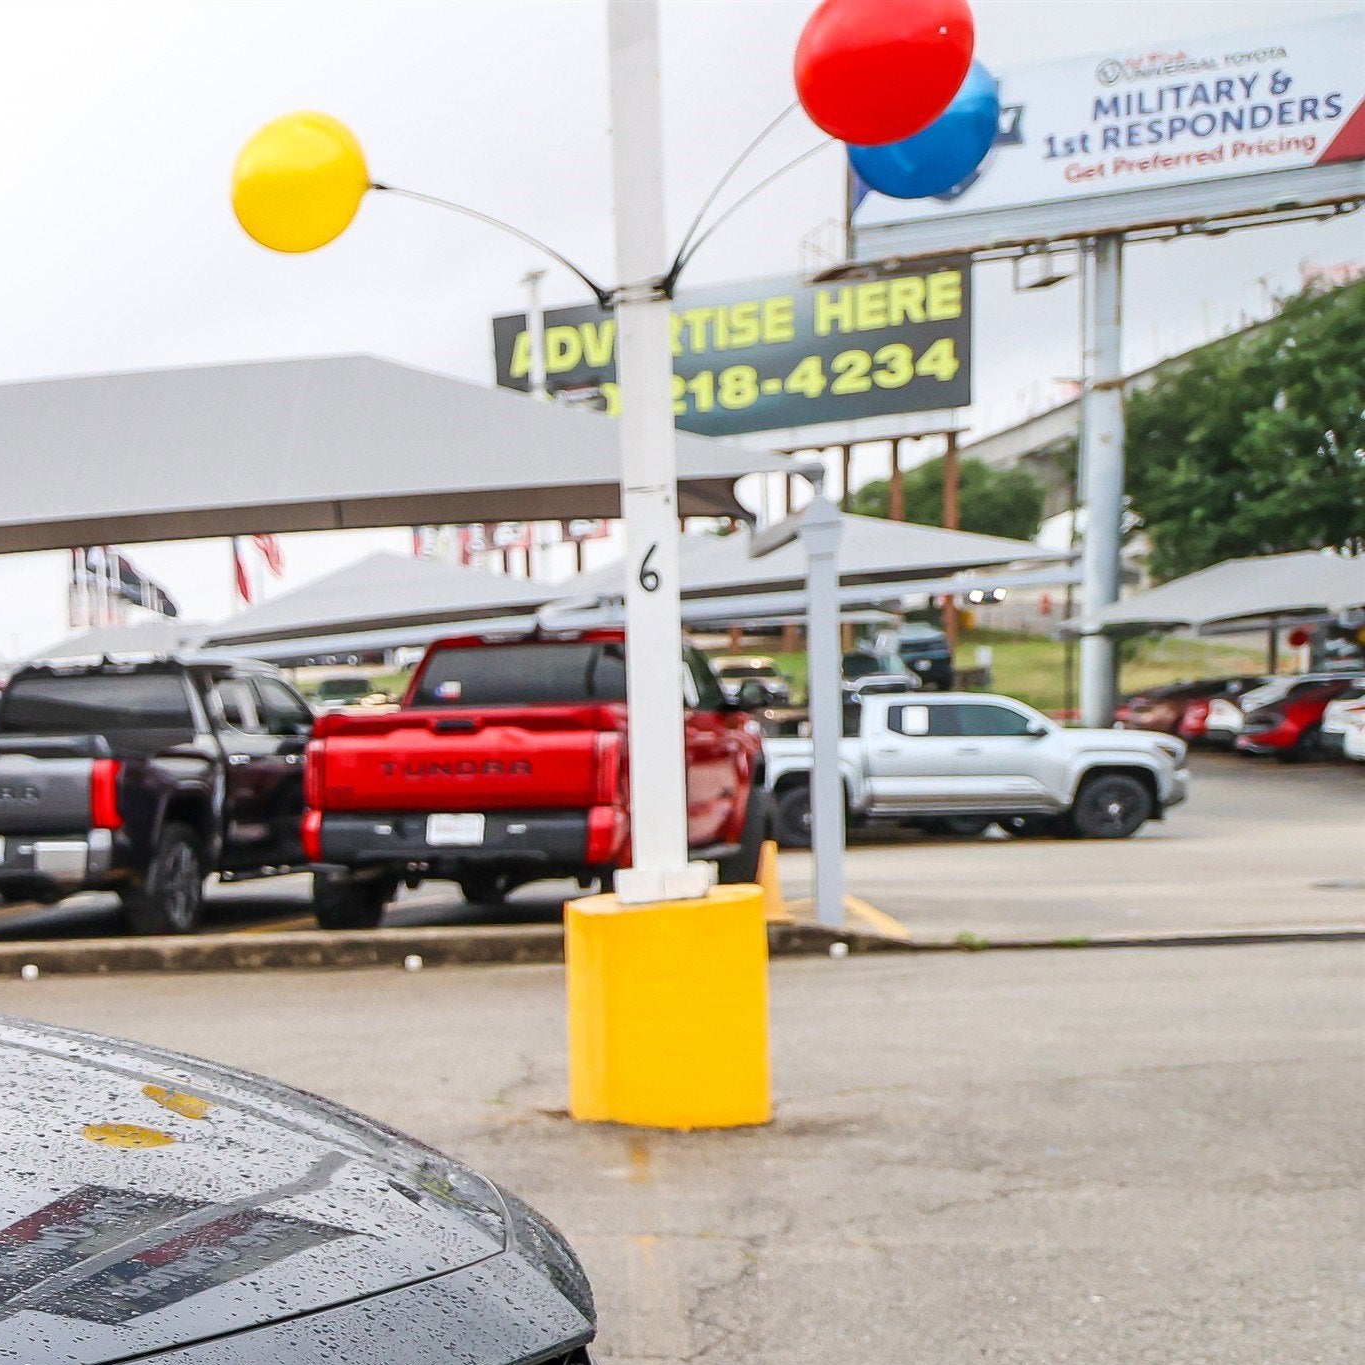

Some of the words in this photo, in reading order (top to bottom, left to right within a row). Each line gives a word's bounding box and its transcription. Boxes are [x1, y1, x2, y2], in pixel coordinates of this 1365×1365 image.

[1092, 71, 1259, 122] MILITARY
[1270, 68, 1294, 96] &
[1043, 129, 1092, 161] 1st
[1101, 93, 1344, 150] RESPONDERS
[1064, 162, 1106, 184] Get
[1112, 144, 1224, 176] Preferred
[1232, 133, 1317, 158] Pricing
[814, 269, 963, 337] HERE
[639, 544, 659, 592] 6
[381, 759, 534, 779] TUNDRA
